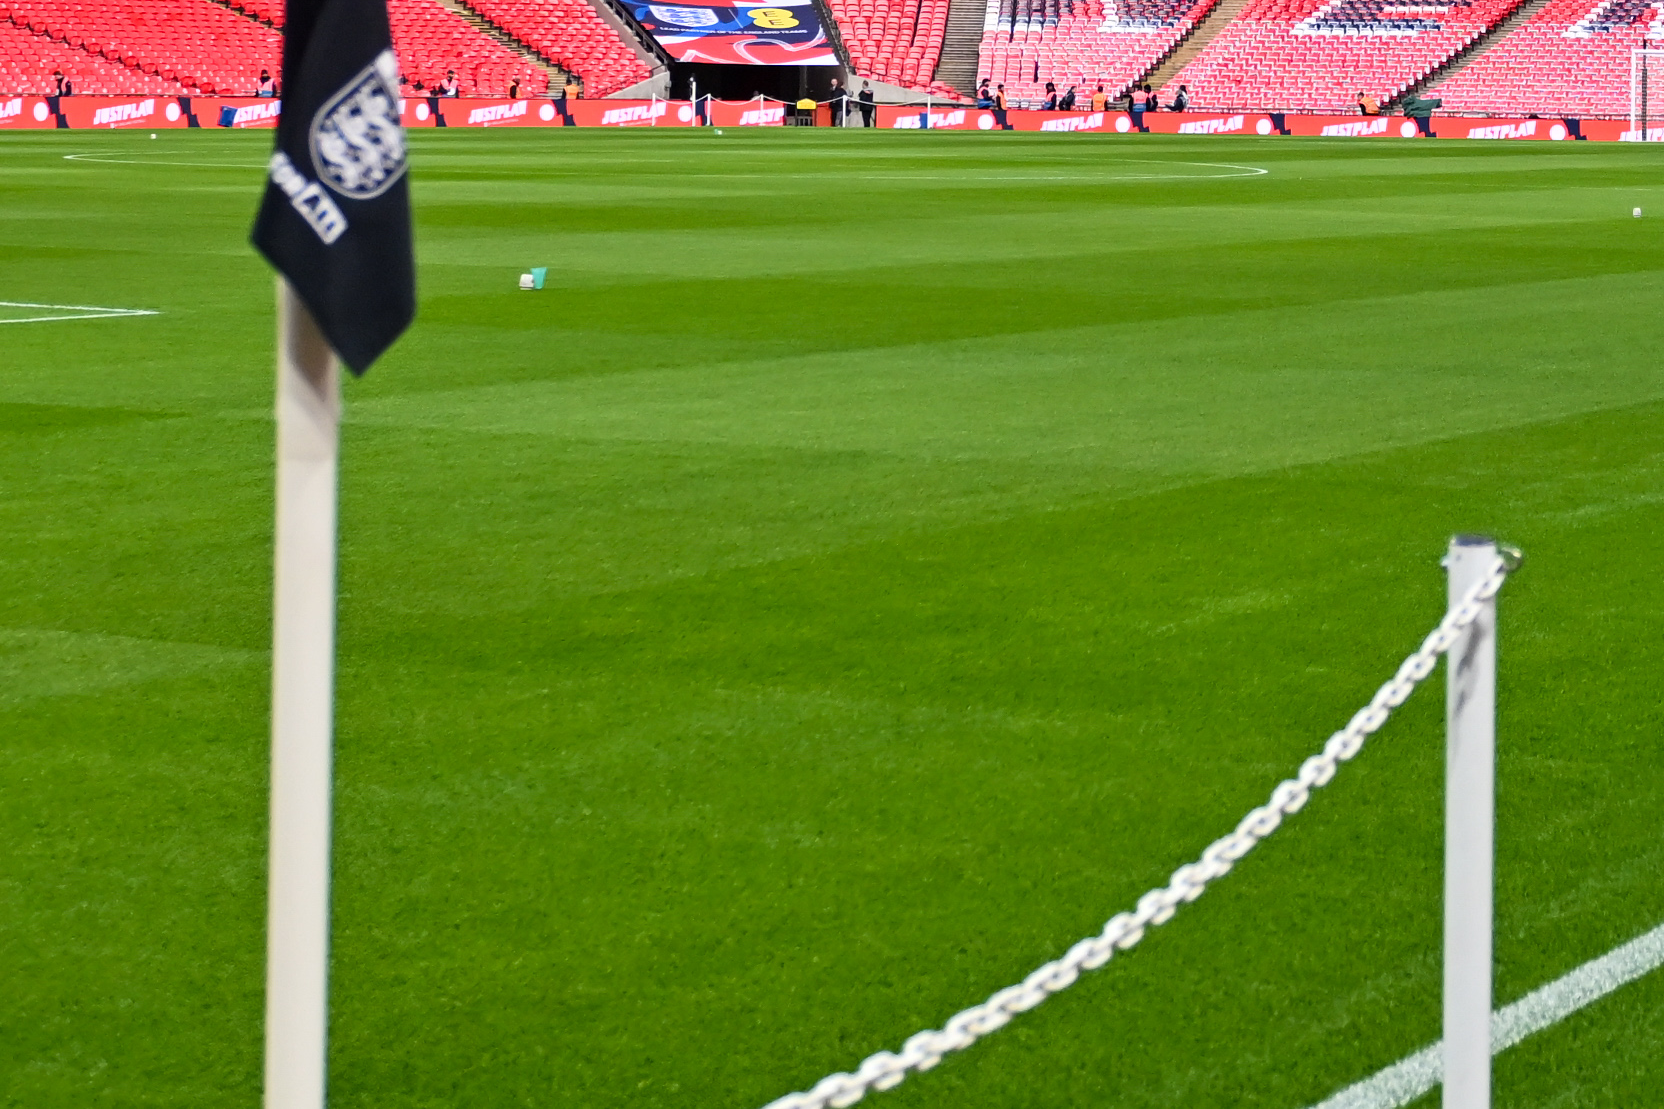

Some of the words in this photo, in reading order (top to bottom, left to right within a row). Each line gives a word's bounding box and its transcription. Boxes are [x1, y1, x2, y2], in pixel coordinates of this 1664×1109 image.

[93, 99, 155, 125] JUSTPLAY
[468, 100, 528, 124] JUSTPLAY
[602, 101, 667, 125] JUSTPLAY
[892, 110, 965, 129] JUSPLAY
[1040, 113, 1105, 132] JUSTPLAY
[1178, 115, 1244, 134] JUSTPLAY
[1320, 117, 1388, 137] JUSTPLAY
[1467, 121, 1536, 139] JUSTPLAY
